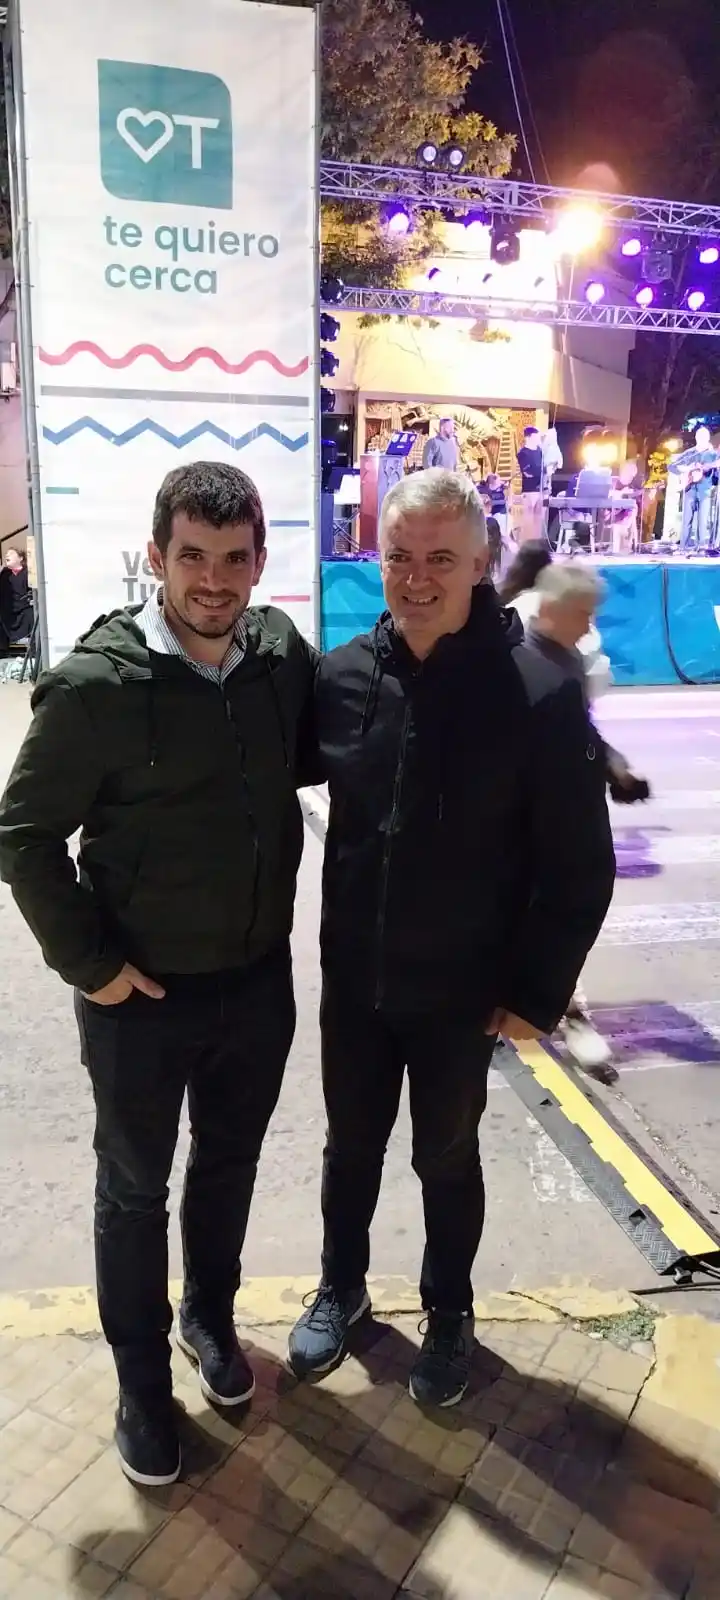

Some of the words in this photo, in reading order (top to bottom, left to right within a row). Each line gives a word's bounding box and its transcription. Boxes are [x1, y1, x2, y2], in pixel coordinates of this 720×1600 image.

[103, 215, 143, 248] te
[154, 220, 279, 262] quiero
[104, 263, 218, 295] cerca
